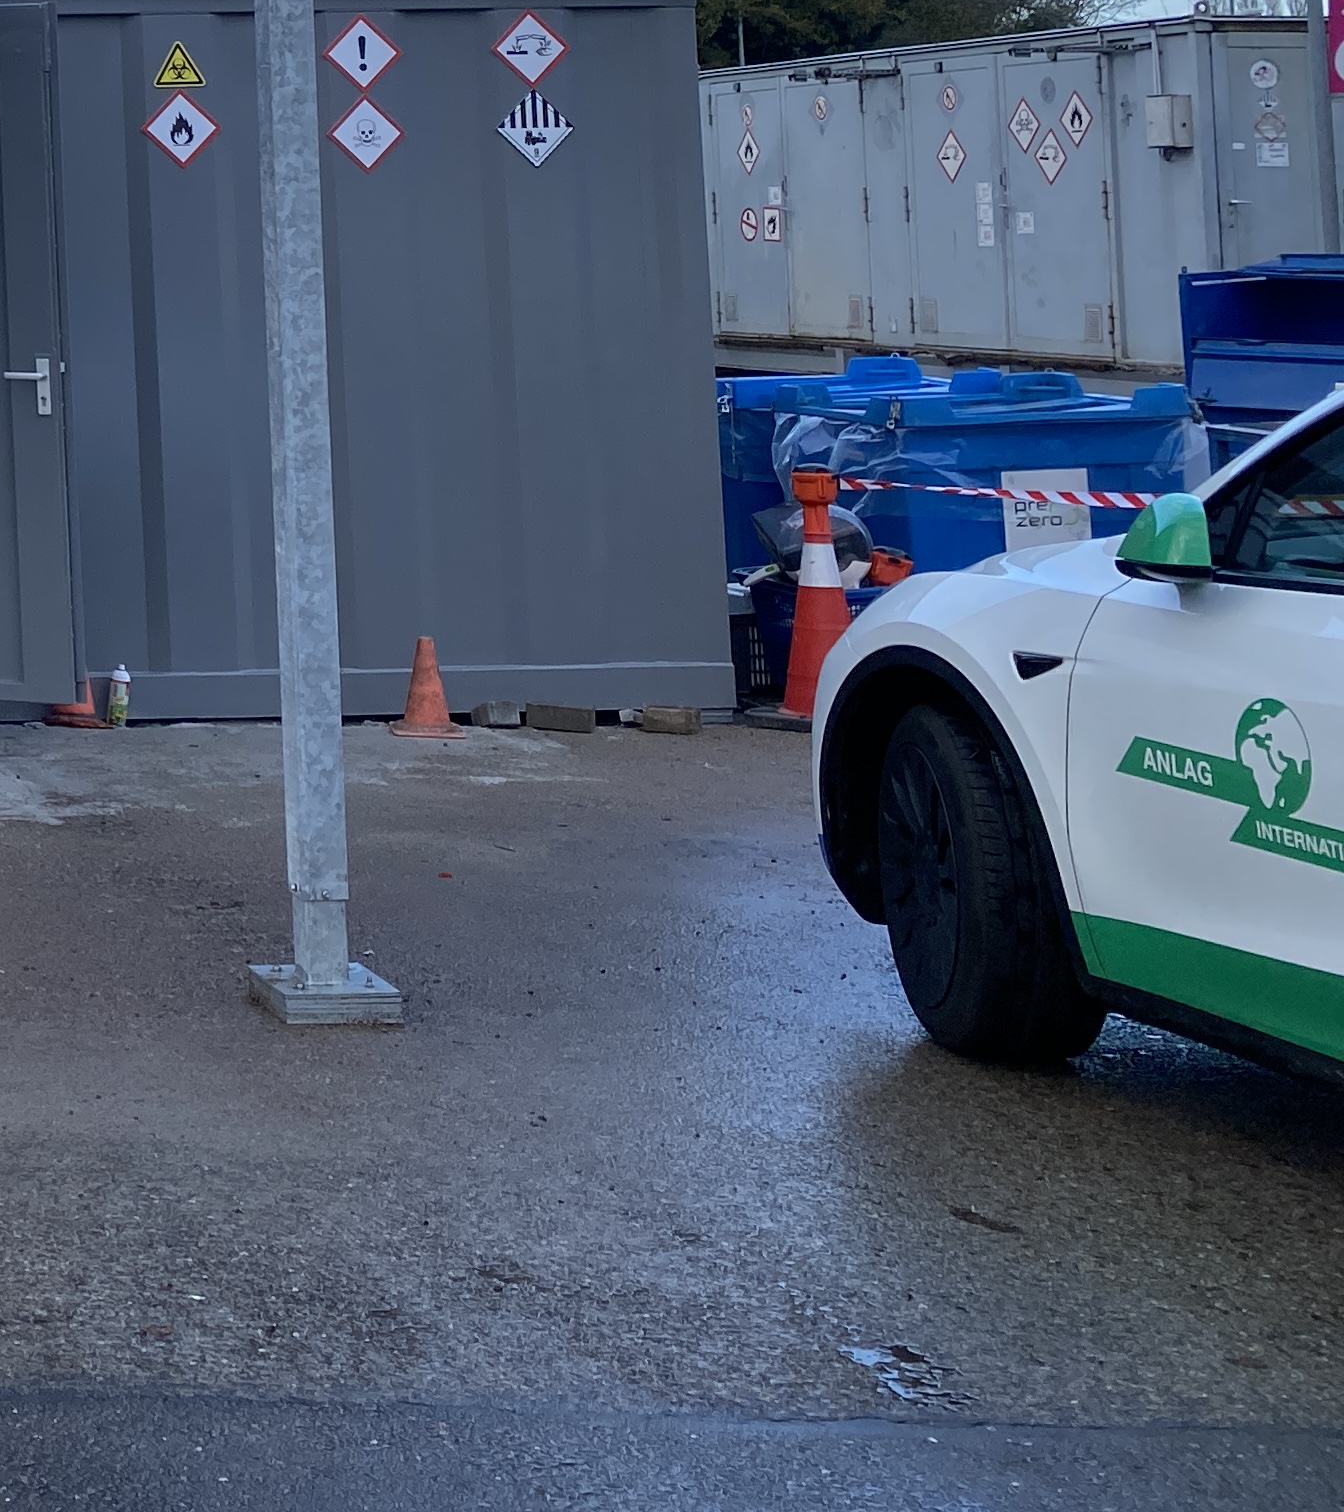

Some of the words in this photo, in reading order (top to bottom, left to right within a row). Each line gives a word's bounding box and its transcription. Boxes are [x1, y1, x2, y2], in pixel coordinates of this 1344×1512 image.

[1015, 501, 1048, 515] pre
[1016, 516, 1062, 527] zero
[1143, 747, 1213, 787] ANLAG
